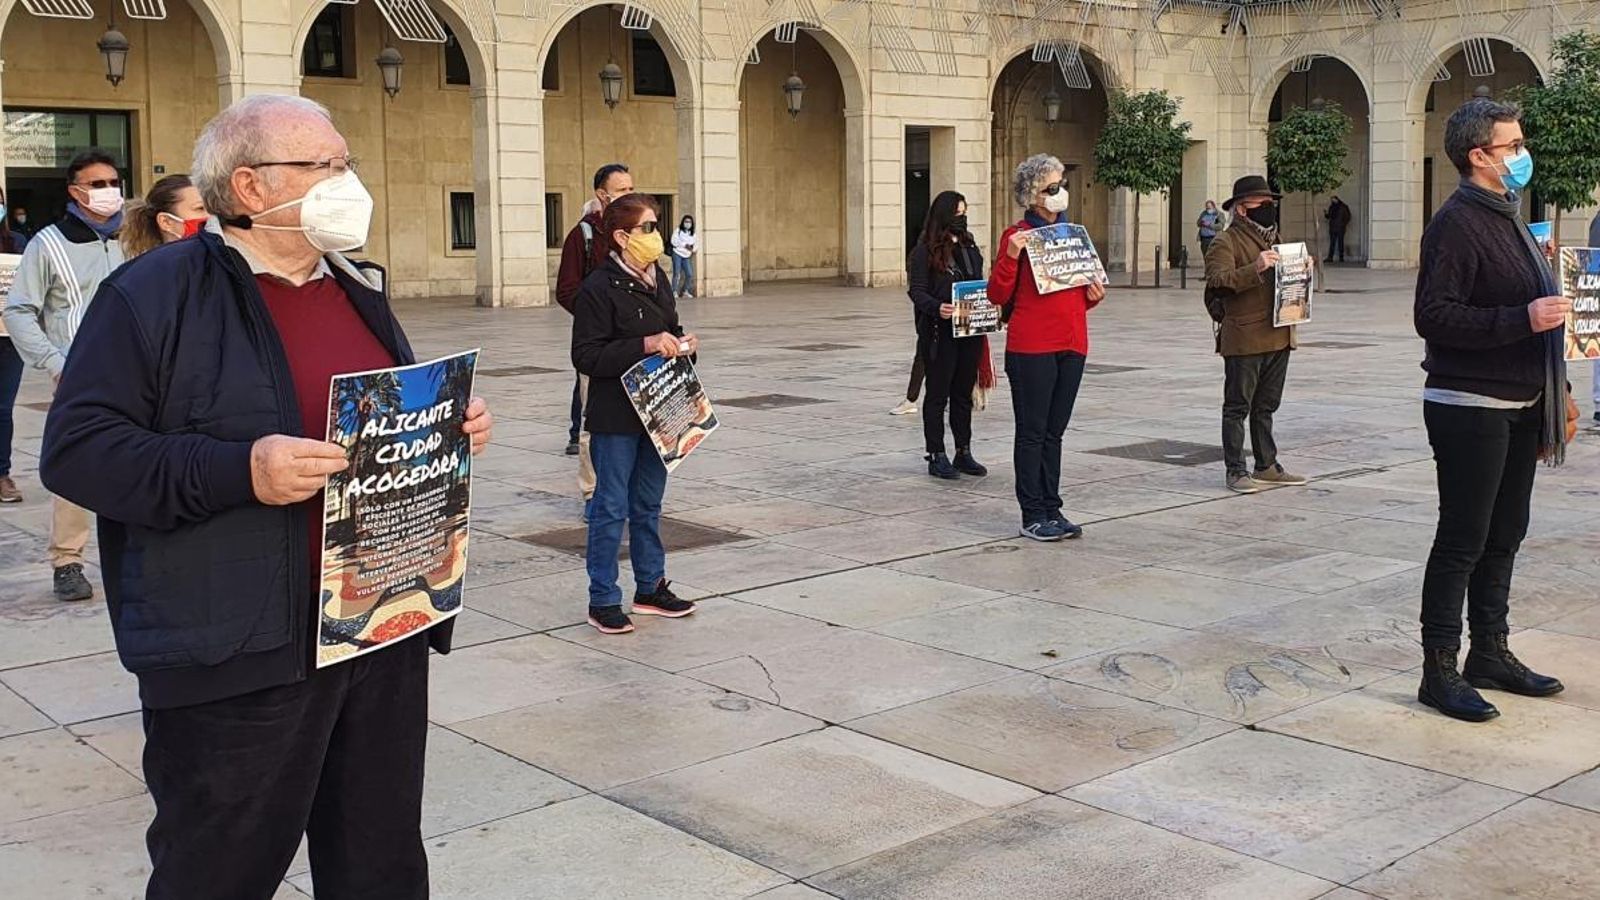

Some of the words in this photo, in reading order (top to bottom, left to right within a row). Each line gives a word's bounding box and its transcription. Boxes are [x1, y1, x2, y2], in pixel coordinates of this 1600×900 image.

[1045, 238, 1084, 249] ALICANTE
[1043, 250, 1078, 263] CONTRA
[1574, 297, 1599, 312] CONTRA
[640, 356, 677, 390] ALICANTE
[649, 371, 675, 395] CIUDAD
[646, 373, 688, 412] ACOGEDORA
[361, 399, 454, 438] ALICANTE
[375, 432, 442, 464] CIUDAD
[346, 451, 459, 498] ACOGEDORA
[383, 501, 400, 509] CON
[413, 484, 450, 500] DESARROLLO
[362, 517, 399, 530] SOCIALES
[365, 508, 404, 520] EFICIENTE
[372, 528, 390, 536] CON
[391, 514, 431, 531] AMPLIACIÓN
[432, 510, 440, 518] DE
[360, 532, 400, 546] RECURSOS
[408, 523, 429, 534] APOYO
[377, 542, 392, 551] RED
[393, 539, 403, 547] DE
[389, 544, 428, 563] PROTECCIÓN
[358, 560, 409, 579] INTERVENCIÓN
[411, 551, 432, 564] SOCIAL
[433, 545, 445, 554] CON
[360, 549, 397, 563] INTEGRAL
[371, 576, 384, 584] LAS
[387, 564, 421, 579] PERSONAS
[357, 577, 407, 596] VULNERABLES
[391, 580, 416, 594] CIUDAD
